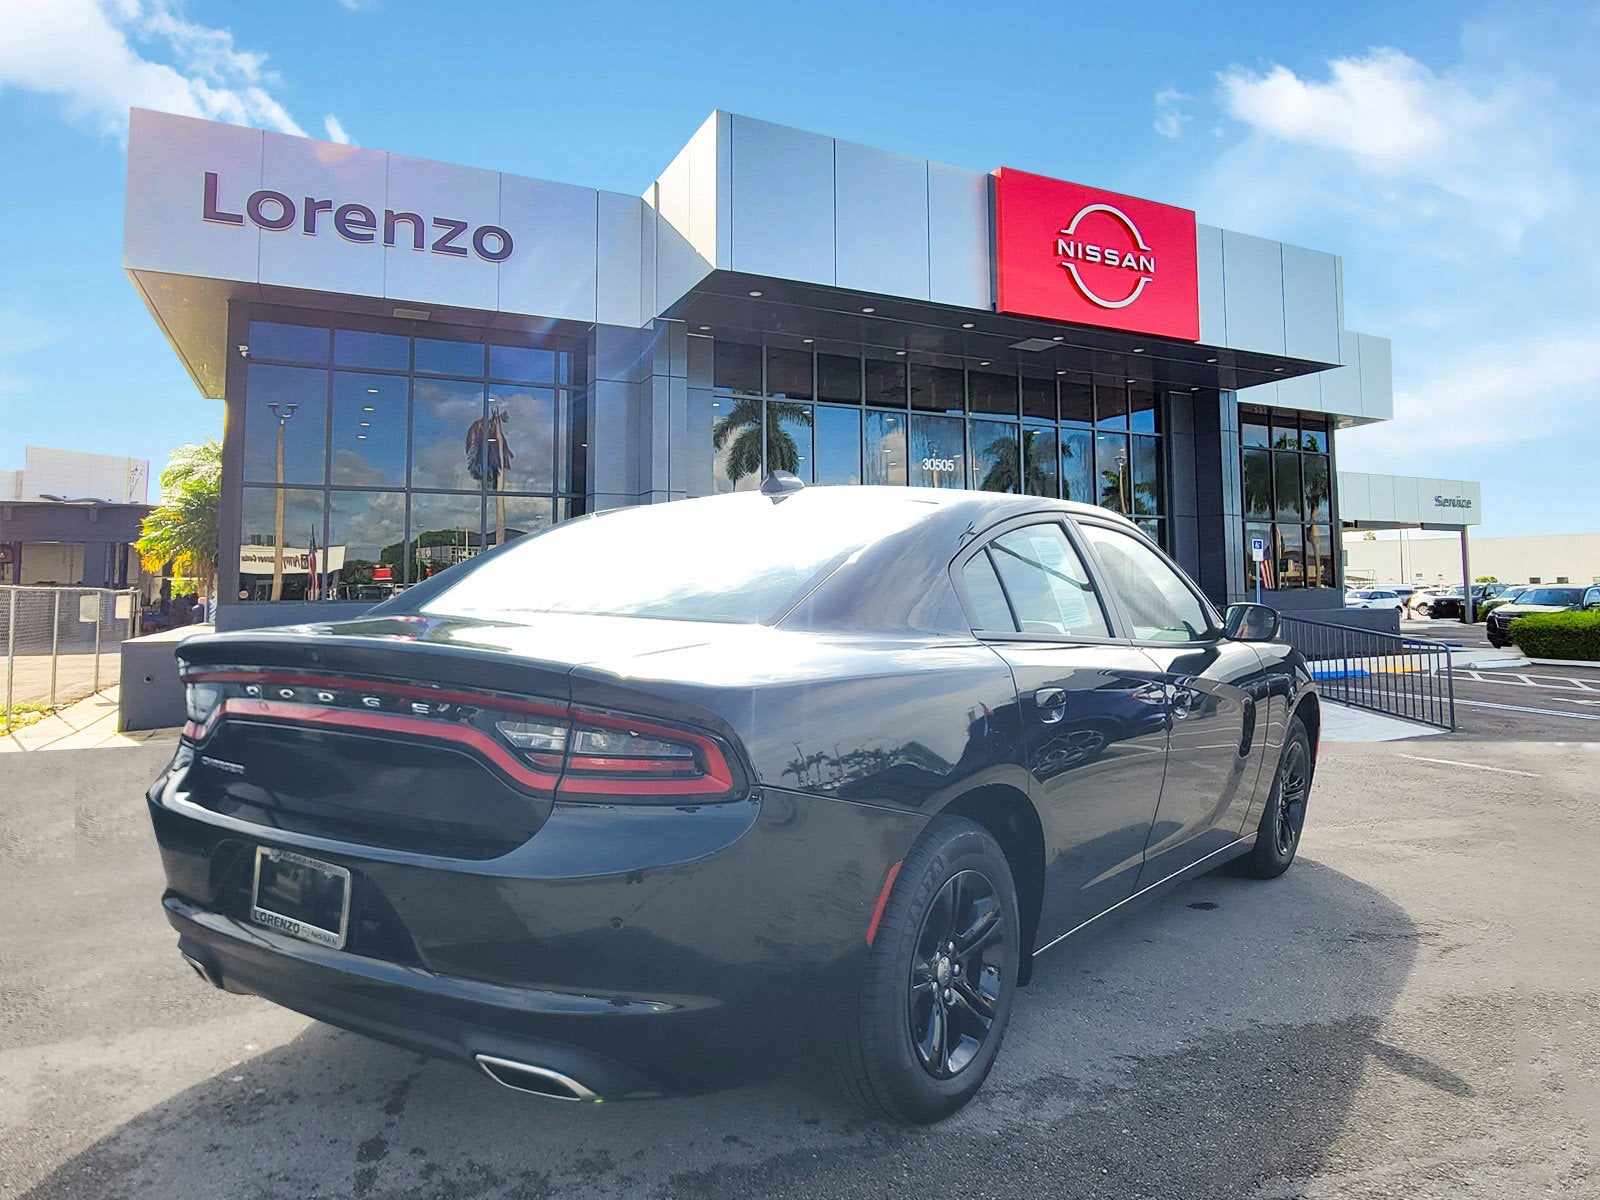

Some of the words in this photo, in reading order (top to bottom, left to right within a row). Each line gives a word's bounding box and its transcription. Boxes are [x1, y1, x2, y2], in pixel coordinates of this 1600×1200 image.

[202, 171, 515, 262] Lorenzo
[1057, 238, 1155, 273] NISSAN
[922, 458, 955, 471] 30505
[1434, 495, 1472, 508] Service
[246, 685, 430, 714] DODGE
[255, 910, 300, 934] LORENZO
